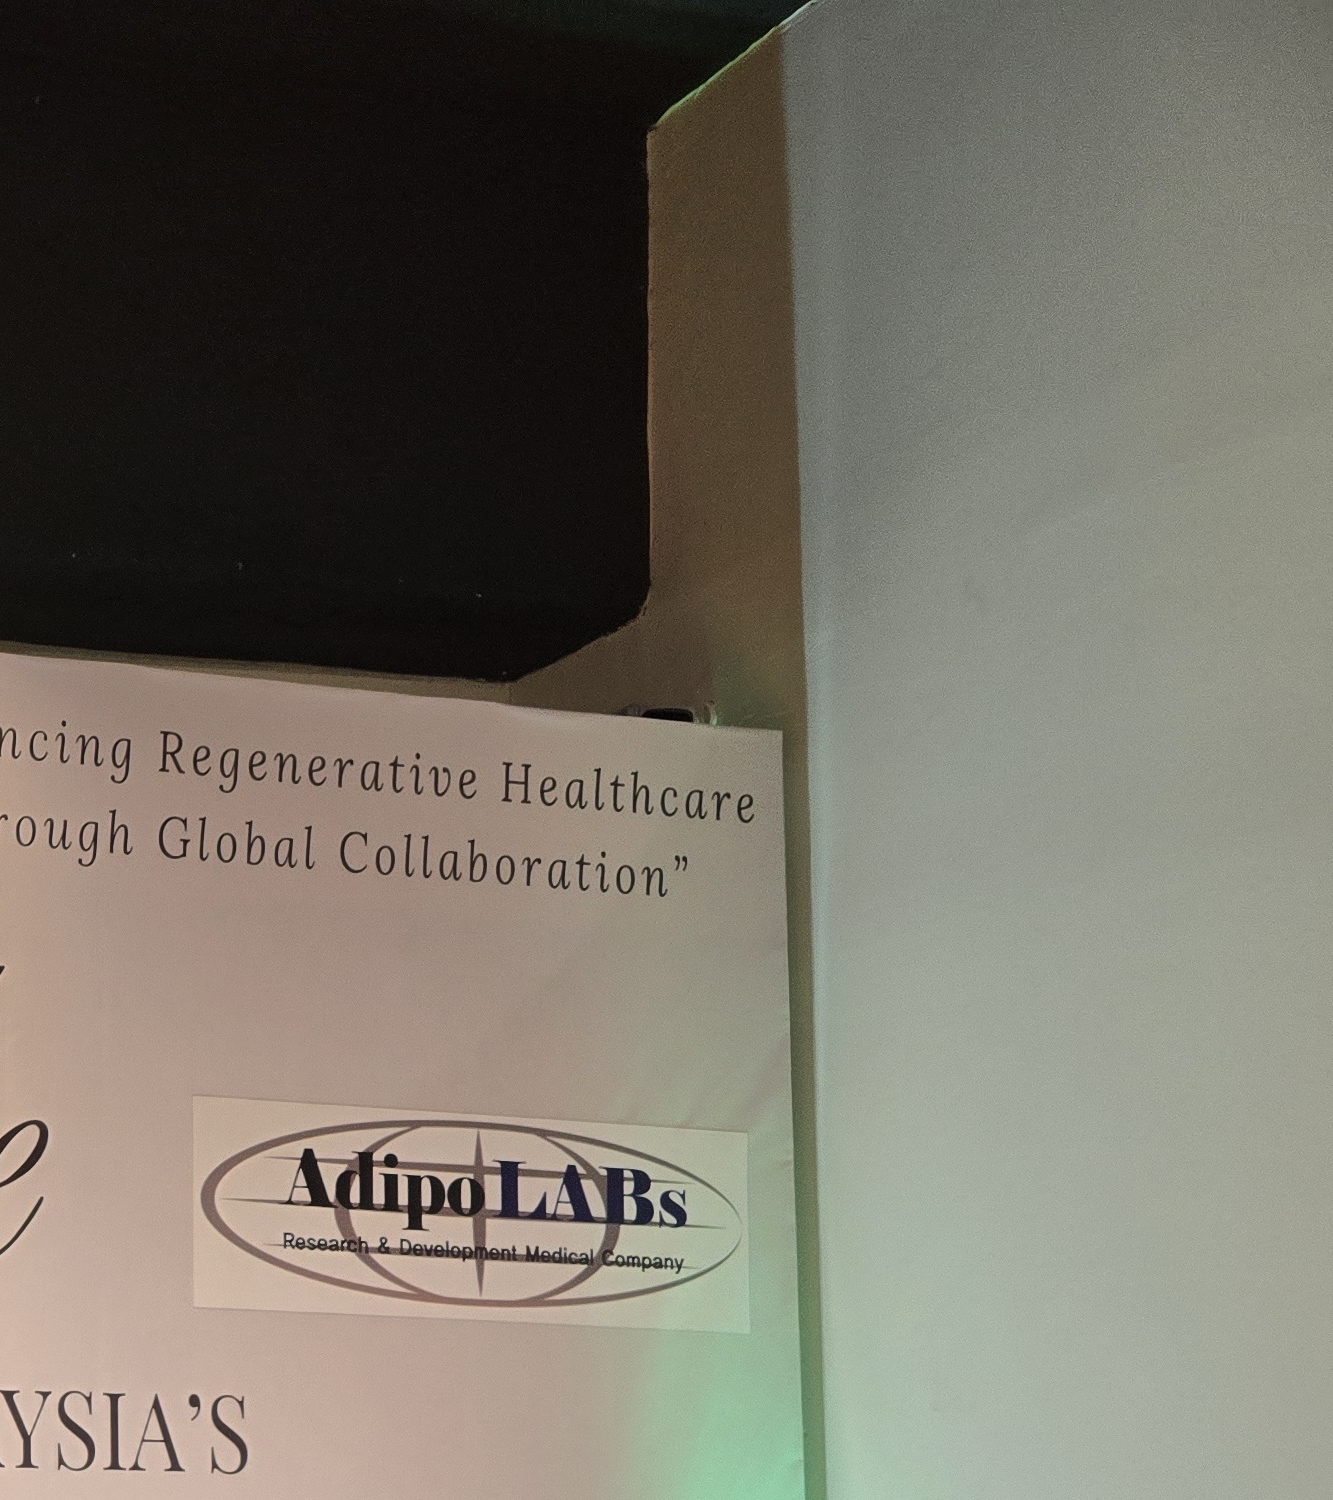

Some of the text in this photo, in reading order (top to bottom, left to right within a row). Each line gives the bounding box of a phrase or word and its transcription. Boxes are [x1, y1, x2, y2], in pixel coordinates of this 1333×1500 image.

[158, 730, 478, 801] Regenerative
[501, 761, 756, 825] Healthcare
[158, 815, 317, 871] Global
[339, 831, 690, 899] Collaboration”
[278, 1147, 688, 1231] AdipoLABs
[282, 1232, 684, 1274] Research & Development Medical Company
